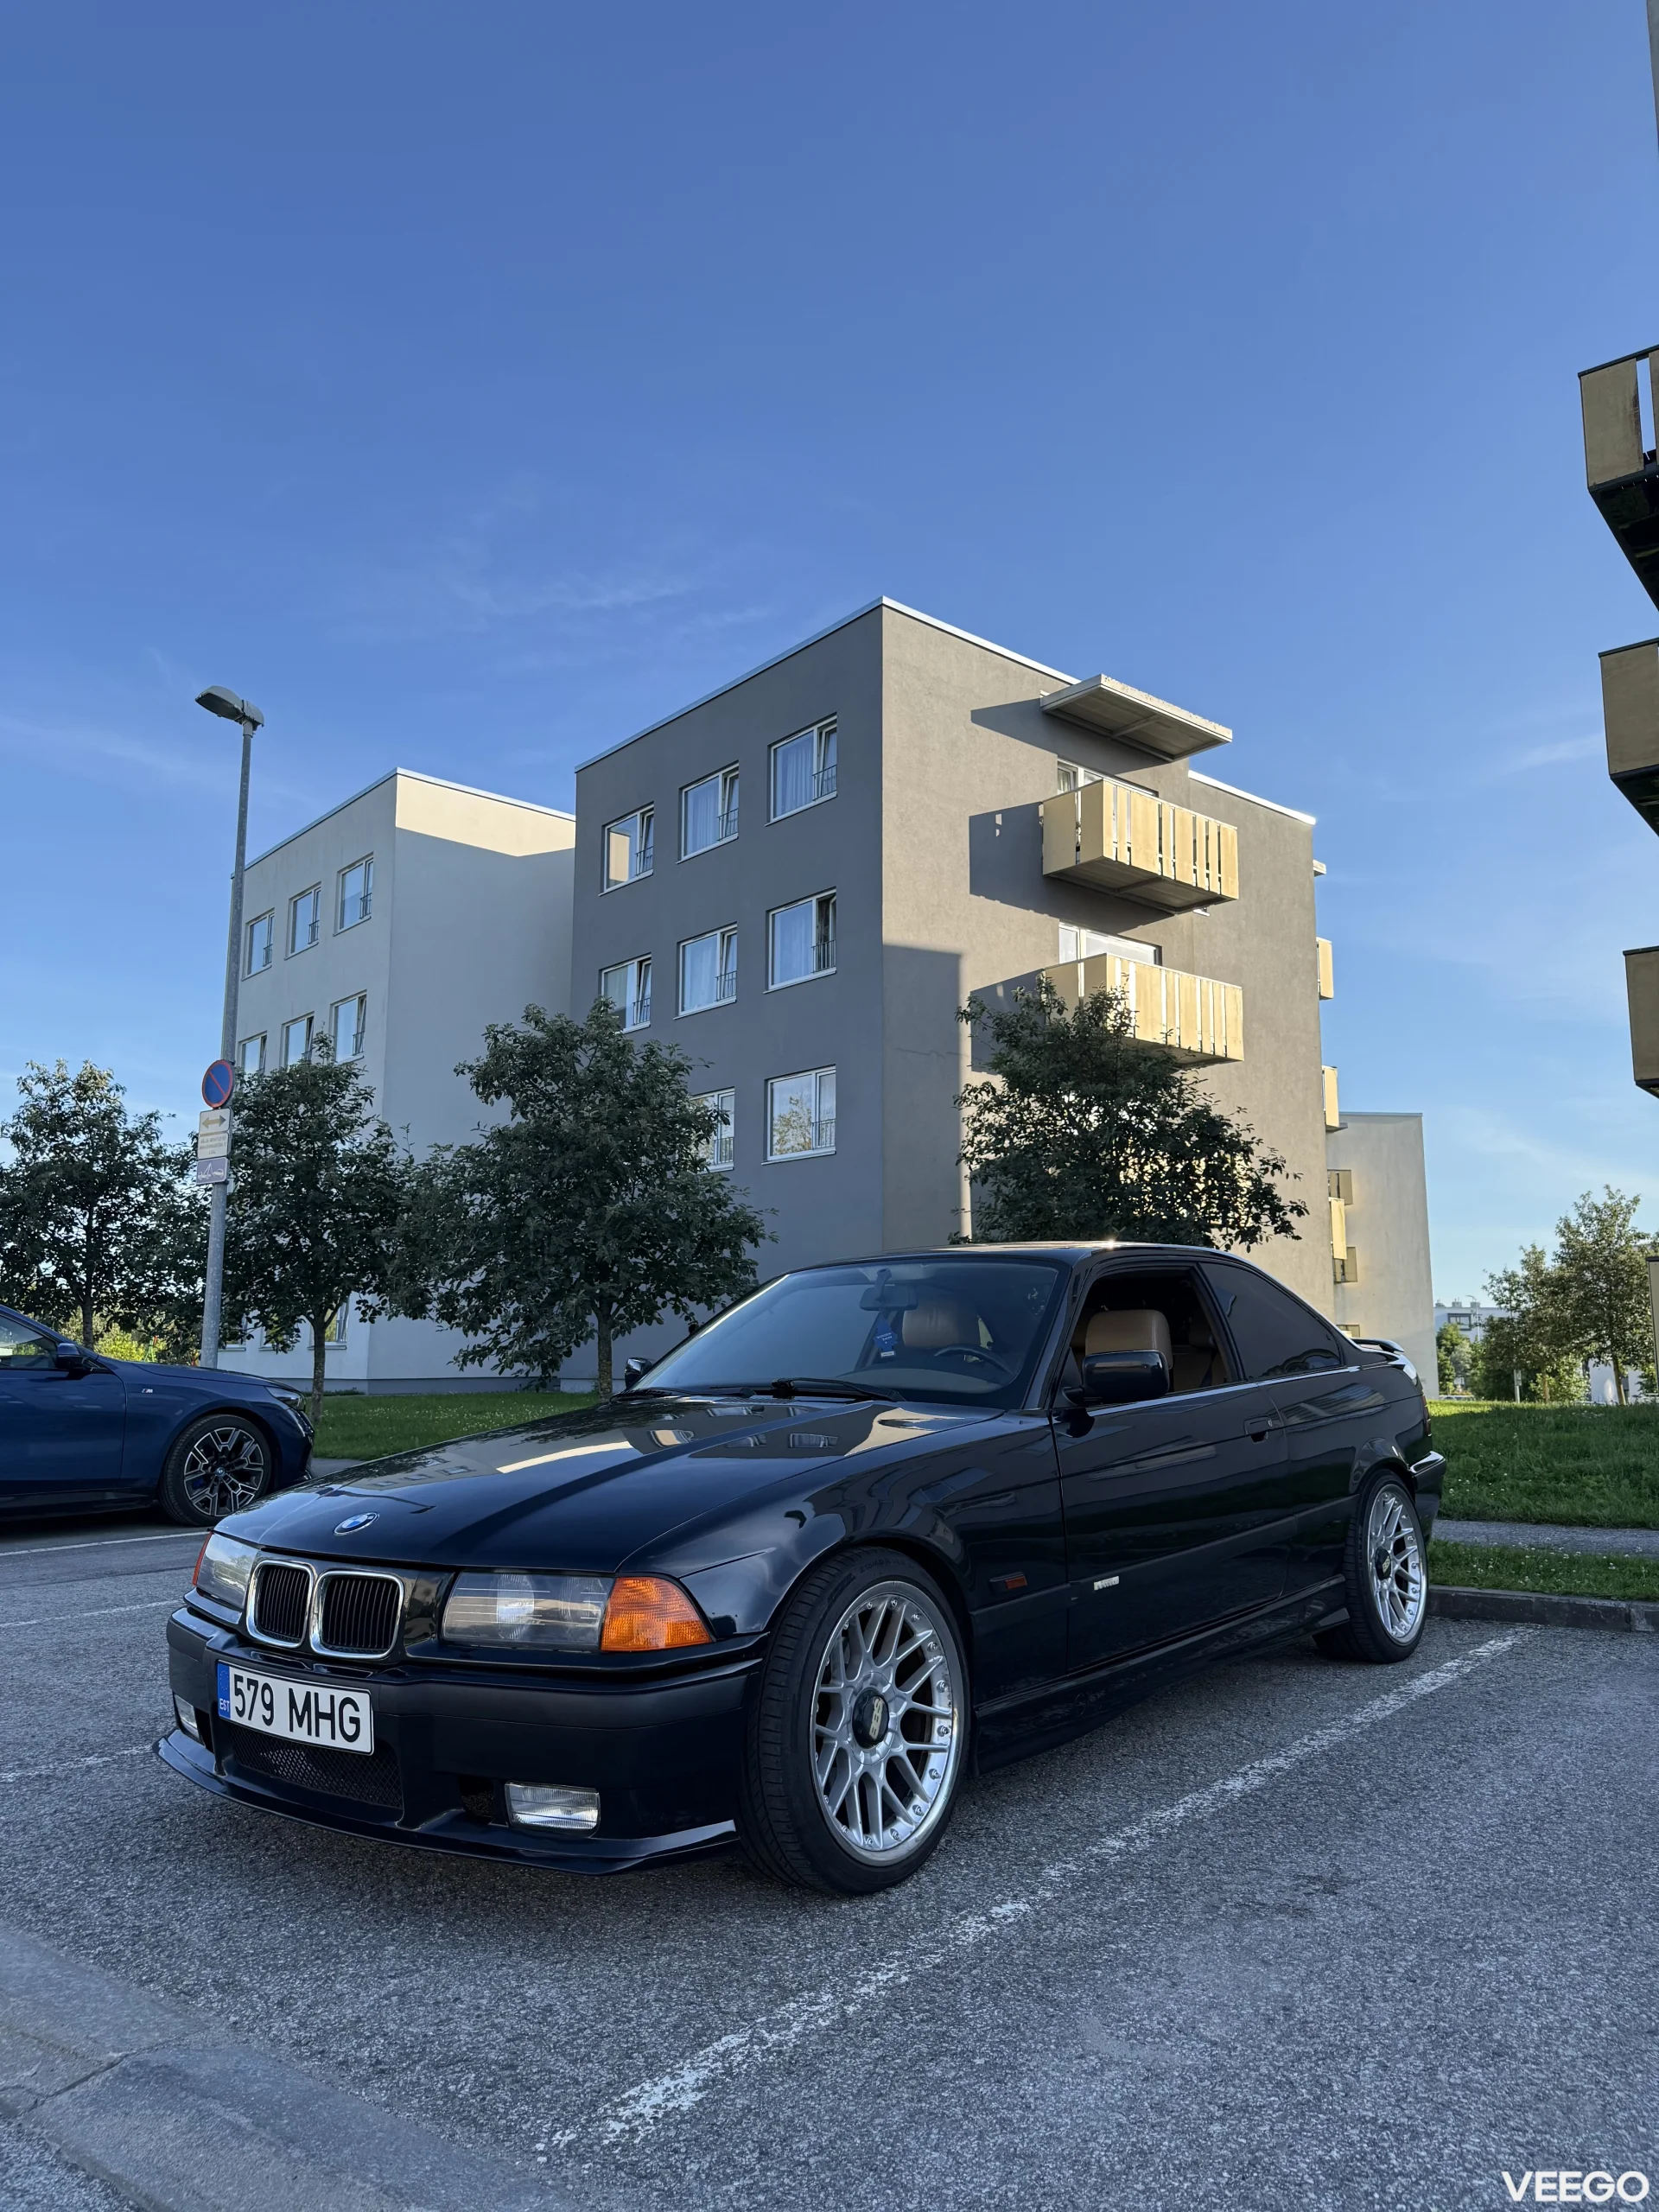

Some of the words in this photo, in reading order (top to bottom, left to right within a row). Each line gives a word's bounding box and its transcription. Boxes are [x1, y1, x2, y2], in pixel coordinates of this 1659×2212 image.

[219, 1698, 231, 1711] EST
[233, 1674, 274, 1726] 579
[289, 1688, 361, 1743] MHG
[869, 1697, 884, 1740] BBS
